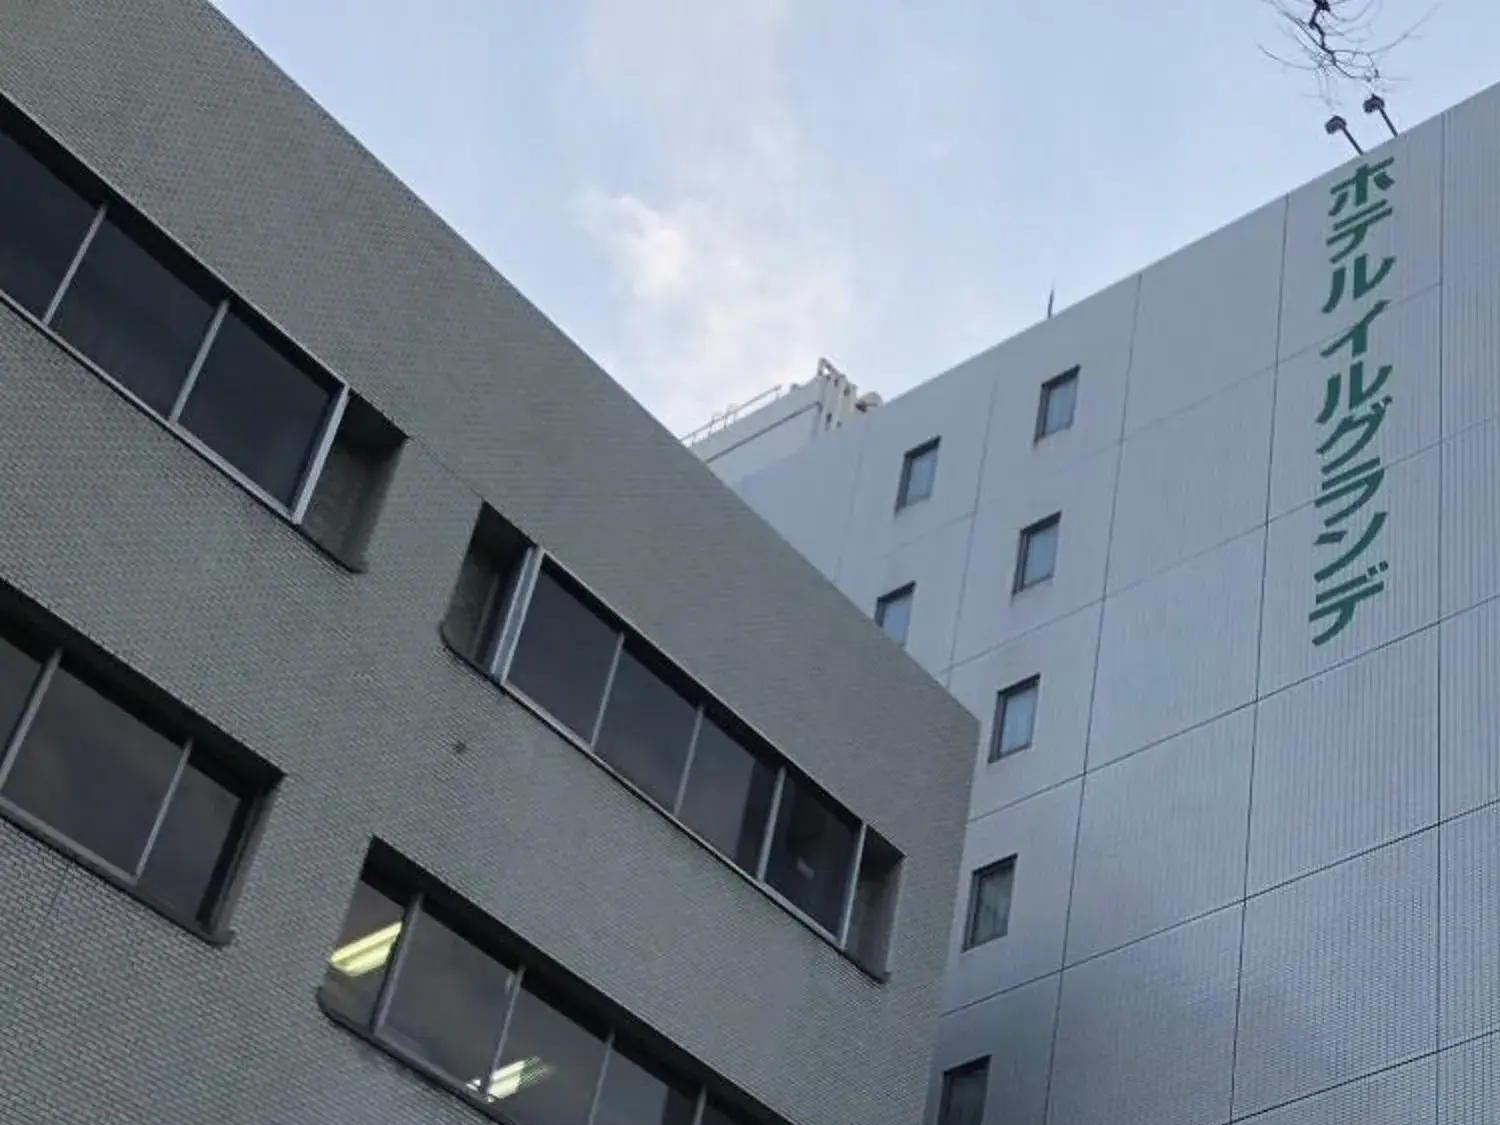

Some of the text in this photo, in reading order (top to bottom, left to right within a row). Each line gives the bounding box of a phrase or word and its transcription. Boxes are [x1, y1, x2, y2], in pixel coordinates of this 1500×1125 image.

[1308, 156, 1397, 648] ホテルイルグランデ
